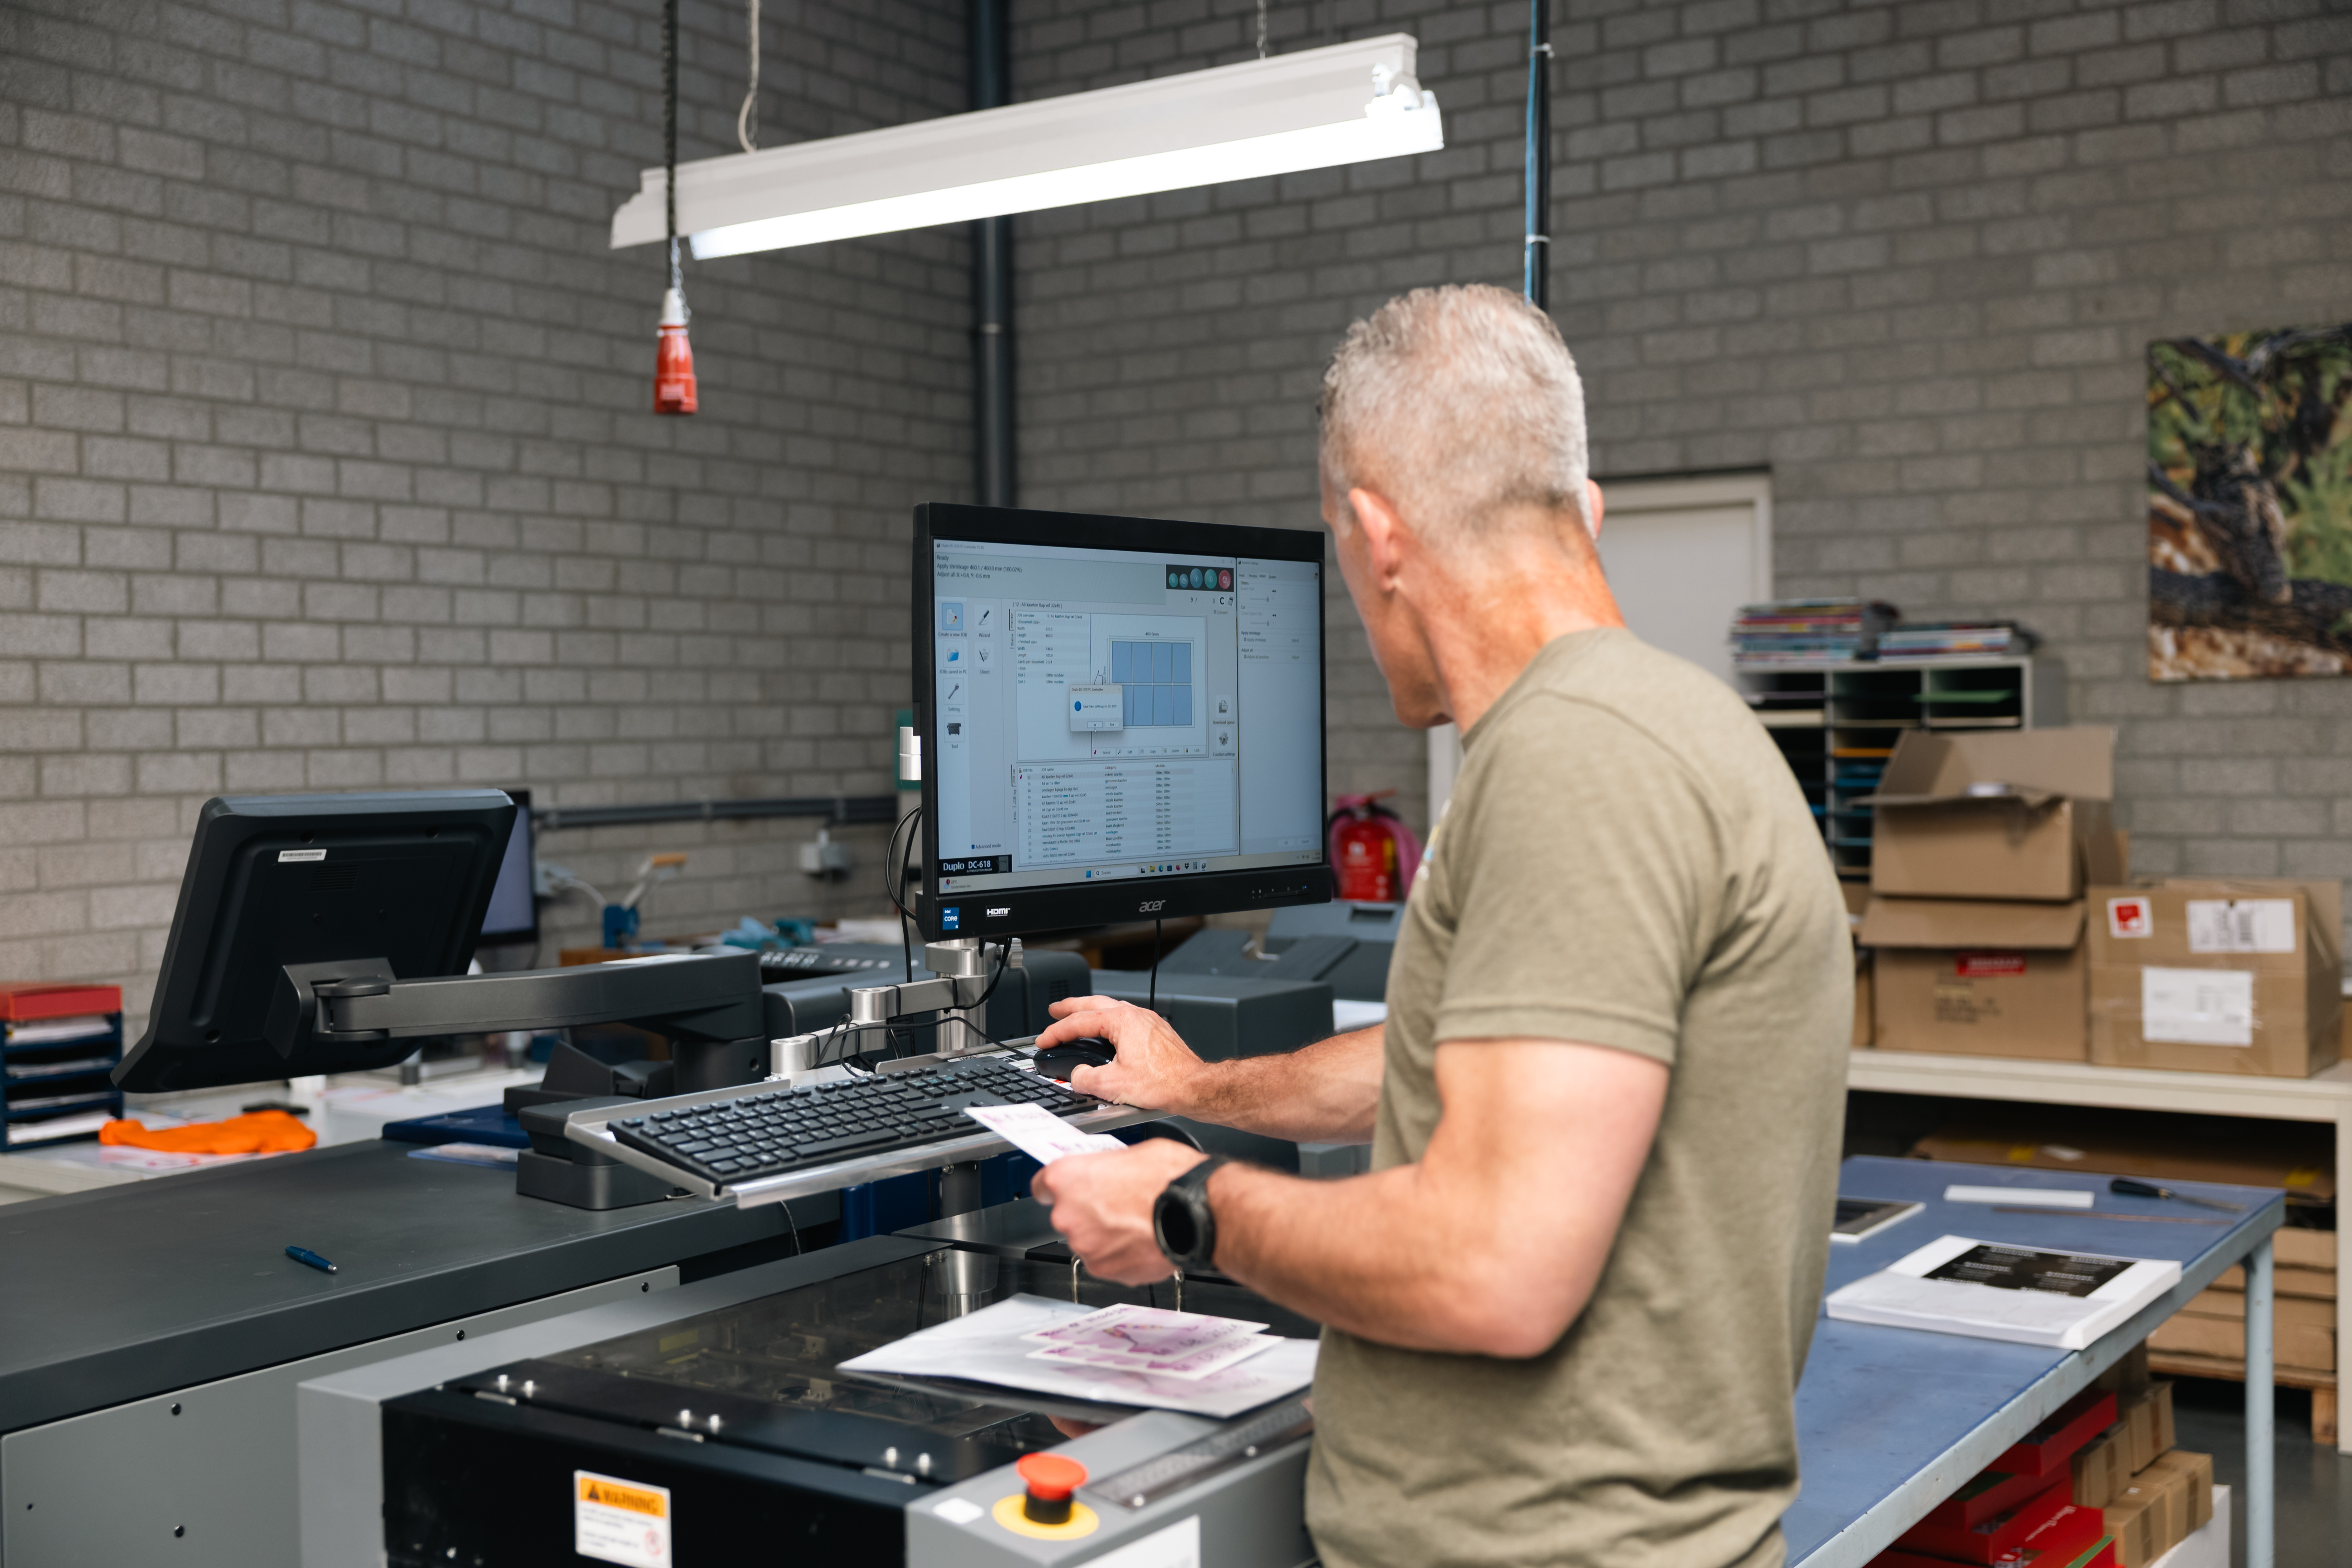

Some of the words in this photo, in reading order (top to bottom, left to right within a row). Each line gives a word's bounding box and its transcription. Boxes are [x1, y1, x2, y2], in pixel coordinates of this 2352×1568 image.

[944, 862, 964, 872] Duplo
[968, 860, 991, 869] DC-618
[1139, 900, 1165, 912] acer
